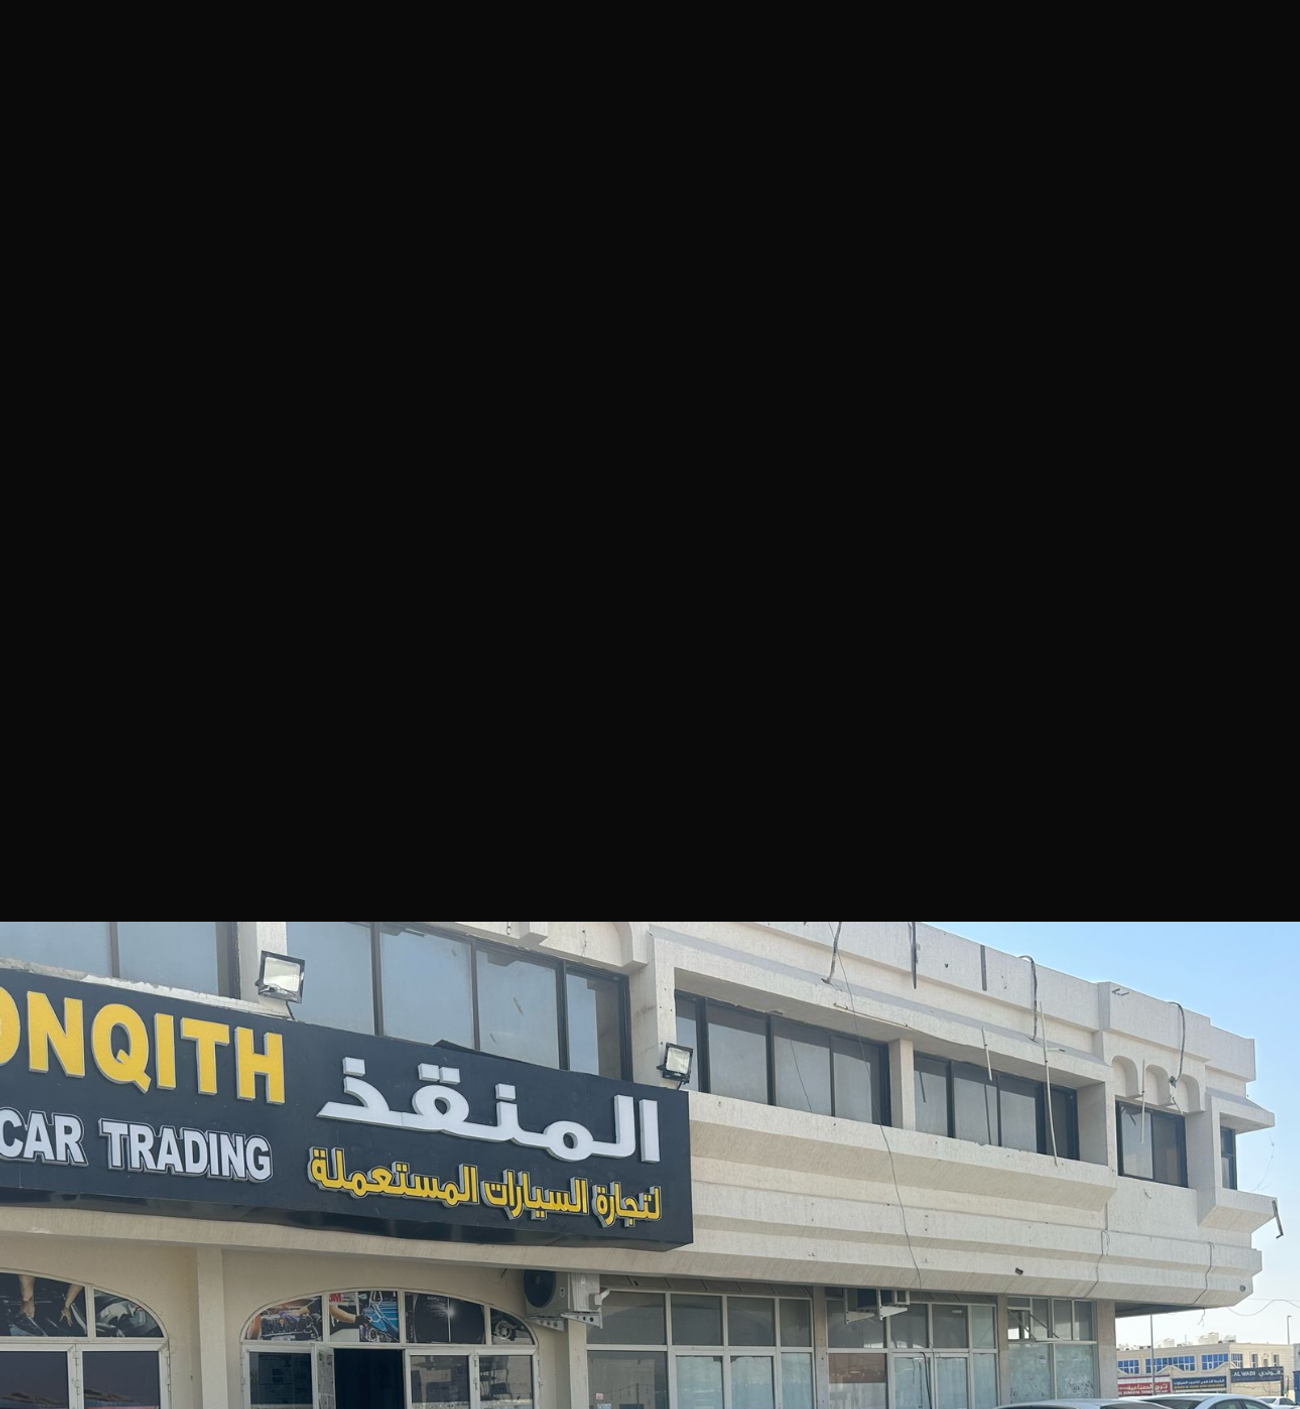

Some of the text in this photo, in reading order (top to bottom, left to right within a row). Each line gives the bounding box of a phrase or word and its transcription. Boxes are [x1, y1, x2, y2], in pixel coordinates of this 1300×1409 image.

[0, 1107, 273, 1183] CAR TRADING
[316, 1057, 661, 1163] المنقذ
[308, 1146, 662, 1228] لتجارة السيارات المستعملة
